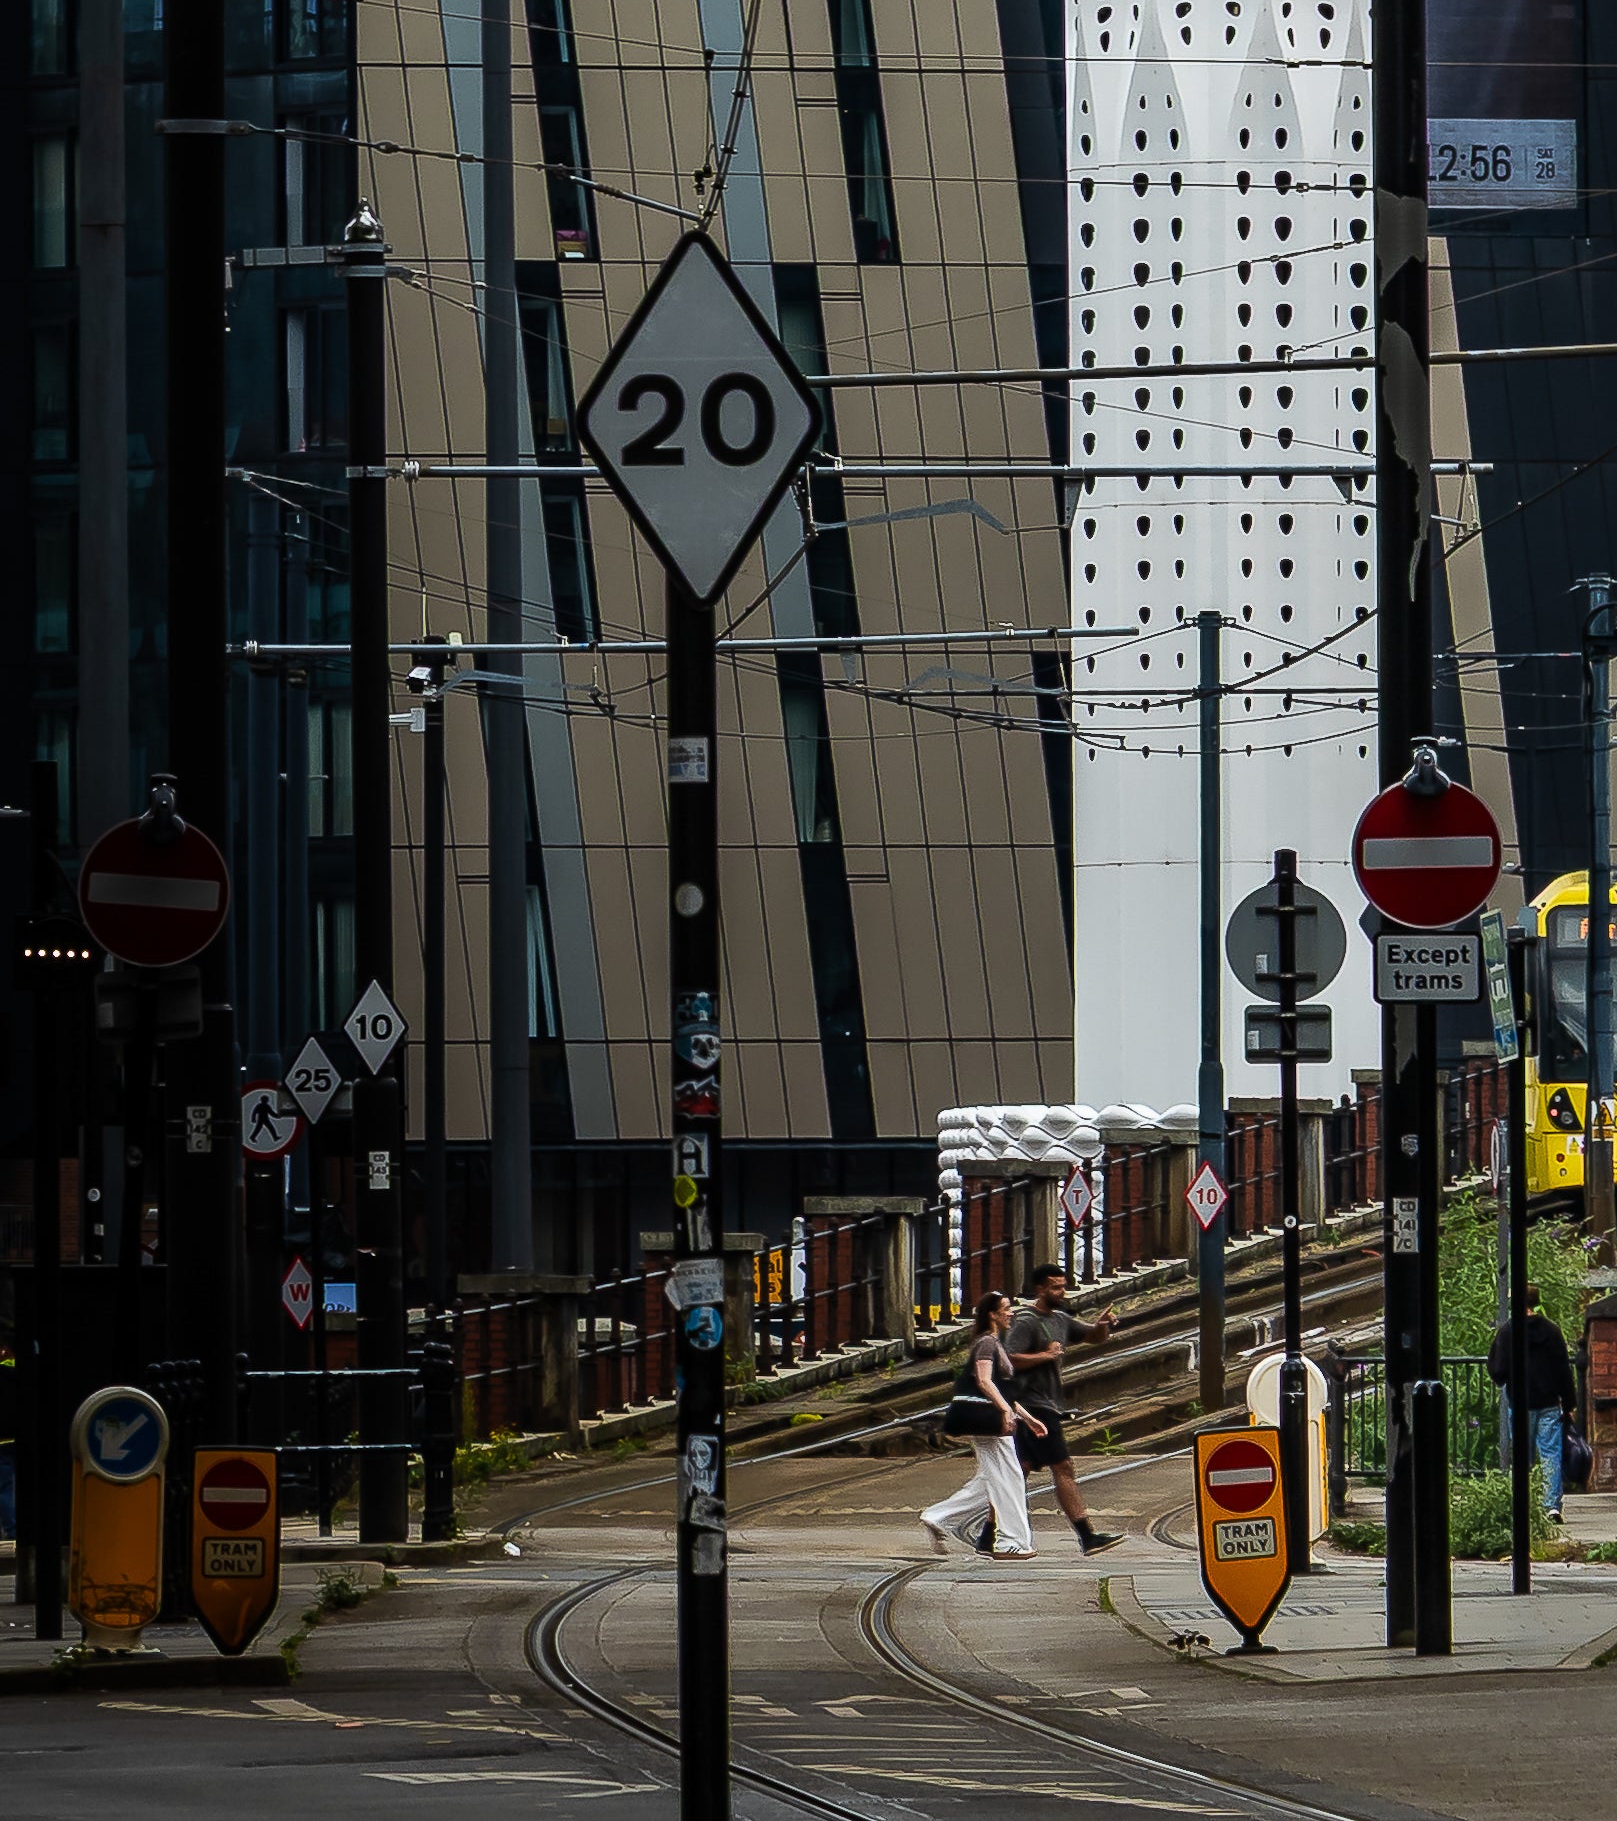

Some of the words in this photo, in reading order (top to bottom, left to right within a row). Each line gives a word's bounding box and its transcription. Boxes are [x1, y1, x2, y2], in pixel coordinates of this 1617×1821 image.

[1428, 144, 1512, 183] 2:56
[1537, 148, 1554, 160] SAT
[1535, 161, 1556, 180] 28
[616, 371, 776, 468] 20
[1386, 944, 1472, 969] Except
[1393, 970, 1464, 991] trams
[354, 1014, 394, 1041] 10
[294, 1068, 333, 1094] 25
[1071, 1188, 1083, 1205] T
[1196, 1186, 1218, 1206] 10
[1399, 1201, 1416, 1213] CD
[288, 1282, 310, 1303] W
[1221, 1522, 1269, 1540] TRAM
[210, 1542, 258, 1558] TRAM
[1222, 1538, 1271, 1558] ONLY
[210, 1558, 257, 1575] ONLY
